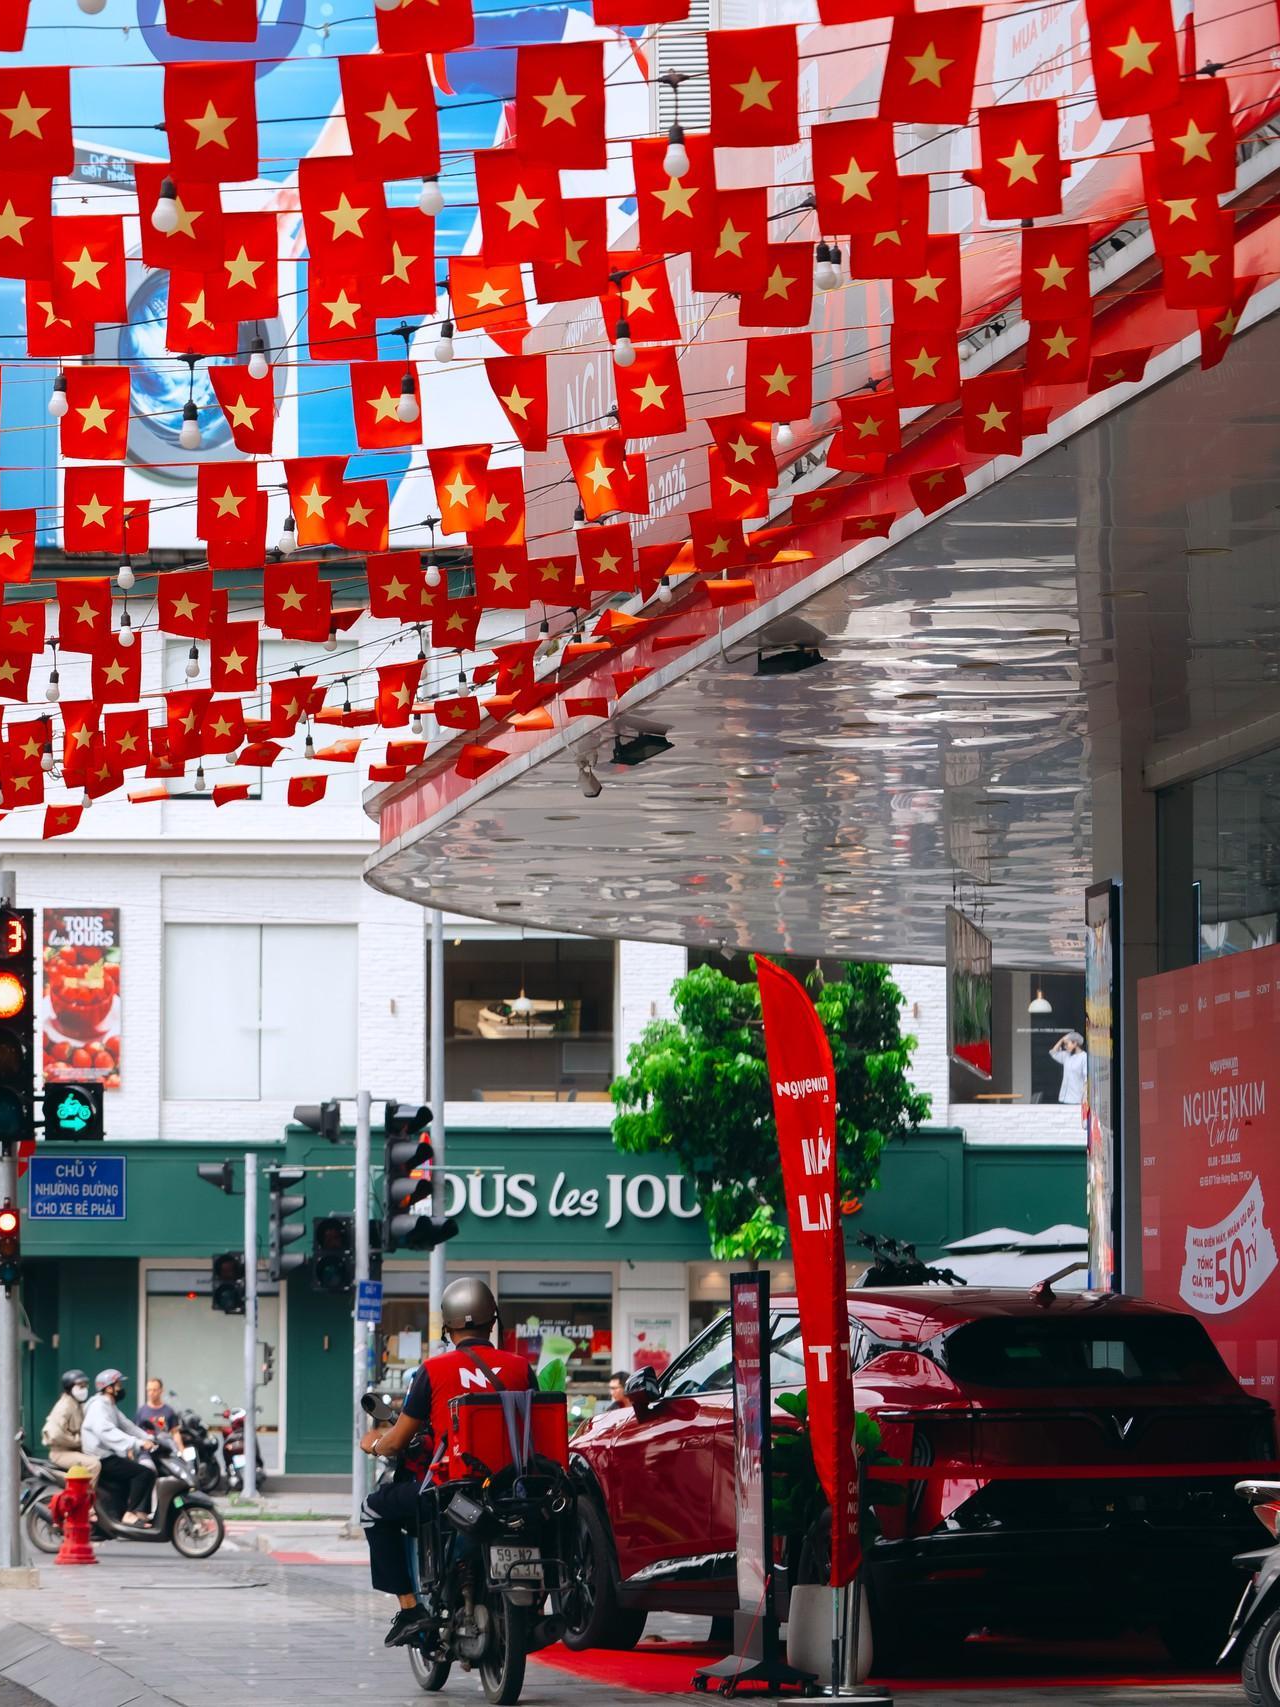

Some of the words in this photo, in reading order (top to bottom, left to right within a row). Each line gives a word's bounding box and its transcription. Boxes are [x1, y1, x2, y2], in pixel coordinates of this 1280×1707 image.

[64, 916, 103, 931] TOUS
[8, 920, 22, 953] 3
[49, 929, 69, 946] les
[68, 931, 114, 946] JOURS
[1183, 1080, 1265, 1128] NGUYENKIM
[89, 1161, 98, 1177] Ý
[35, 1202, 57, 1215] CHO
[60, 1202, 73, 1215] XE
[91, 1199, 116, 1216] PHẢI
[548, 1172, 599, 1217] les
[605, 1174, 702, 1229] JOU
[1215, 1237, 1246, 1306] 50
[1192, 1273, 1203, 1288] GIÁ
[516, 1324, 562, 1339] MATCHA
[563, 1324, 594, 1339] CLUB
